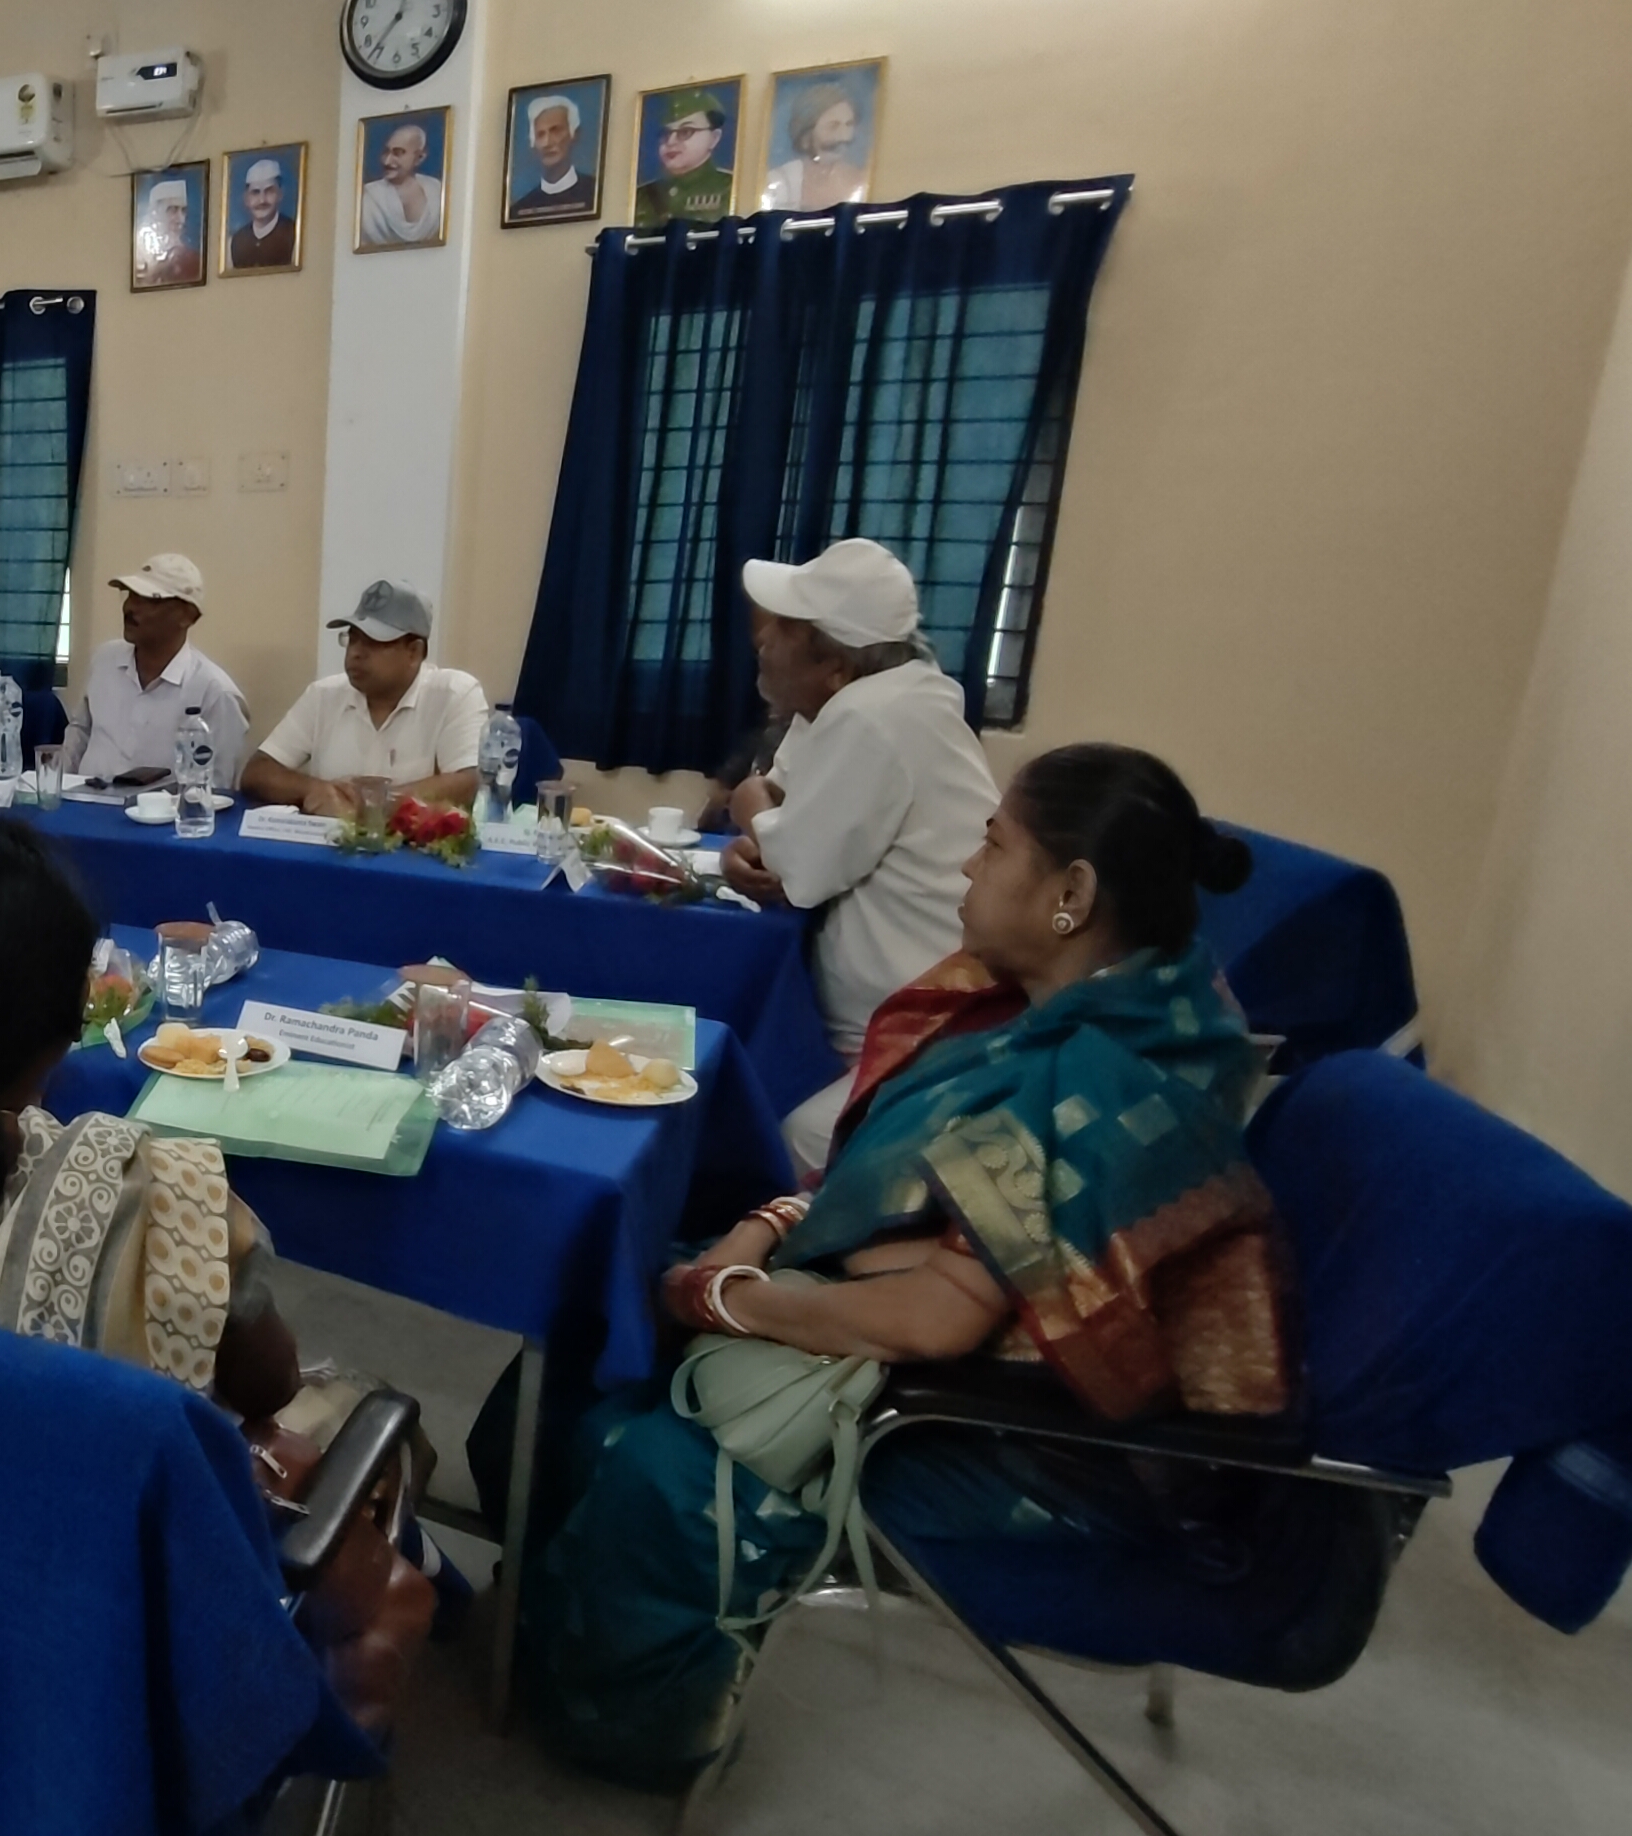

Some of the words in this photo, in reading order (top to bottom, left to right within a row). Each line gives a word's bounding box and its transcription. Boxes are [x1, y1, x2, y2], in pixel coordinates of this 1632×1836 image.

[432, 4, 441, 18] 3
[360, 15, 369, 29] 9
[392, 50, 402, 64] 6
[264, 1012, 277, 1022] Dr.
[279, 1014, 346, 1035] Ramachandra
[347, 1027, 379, 1041] Panda
